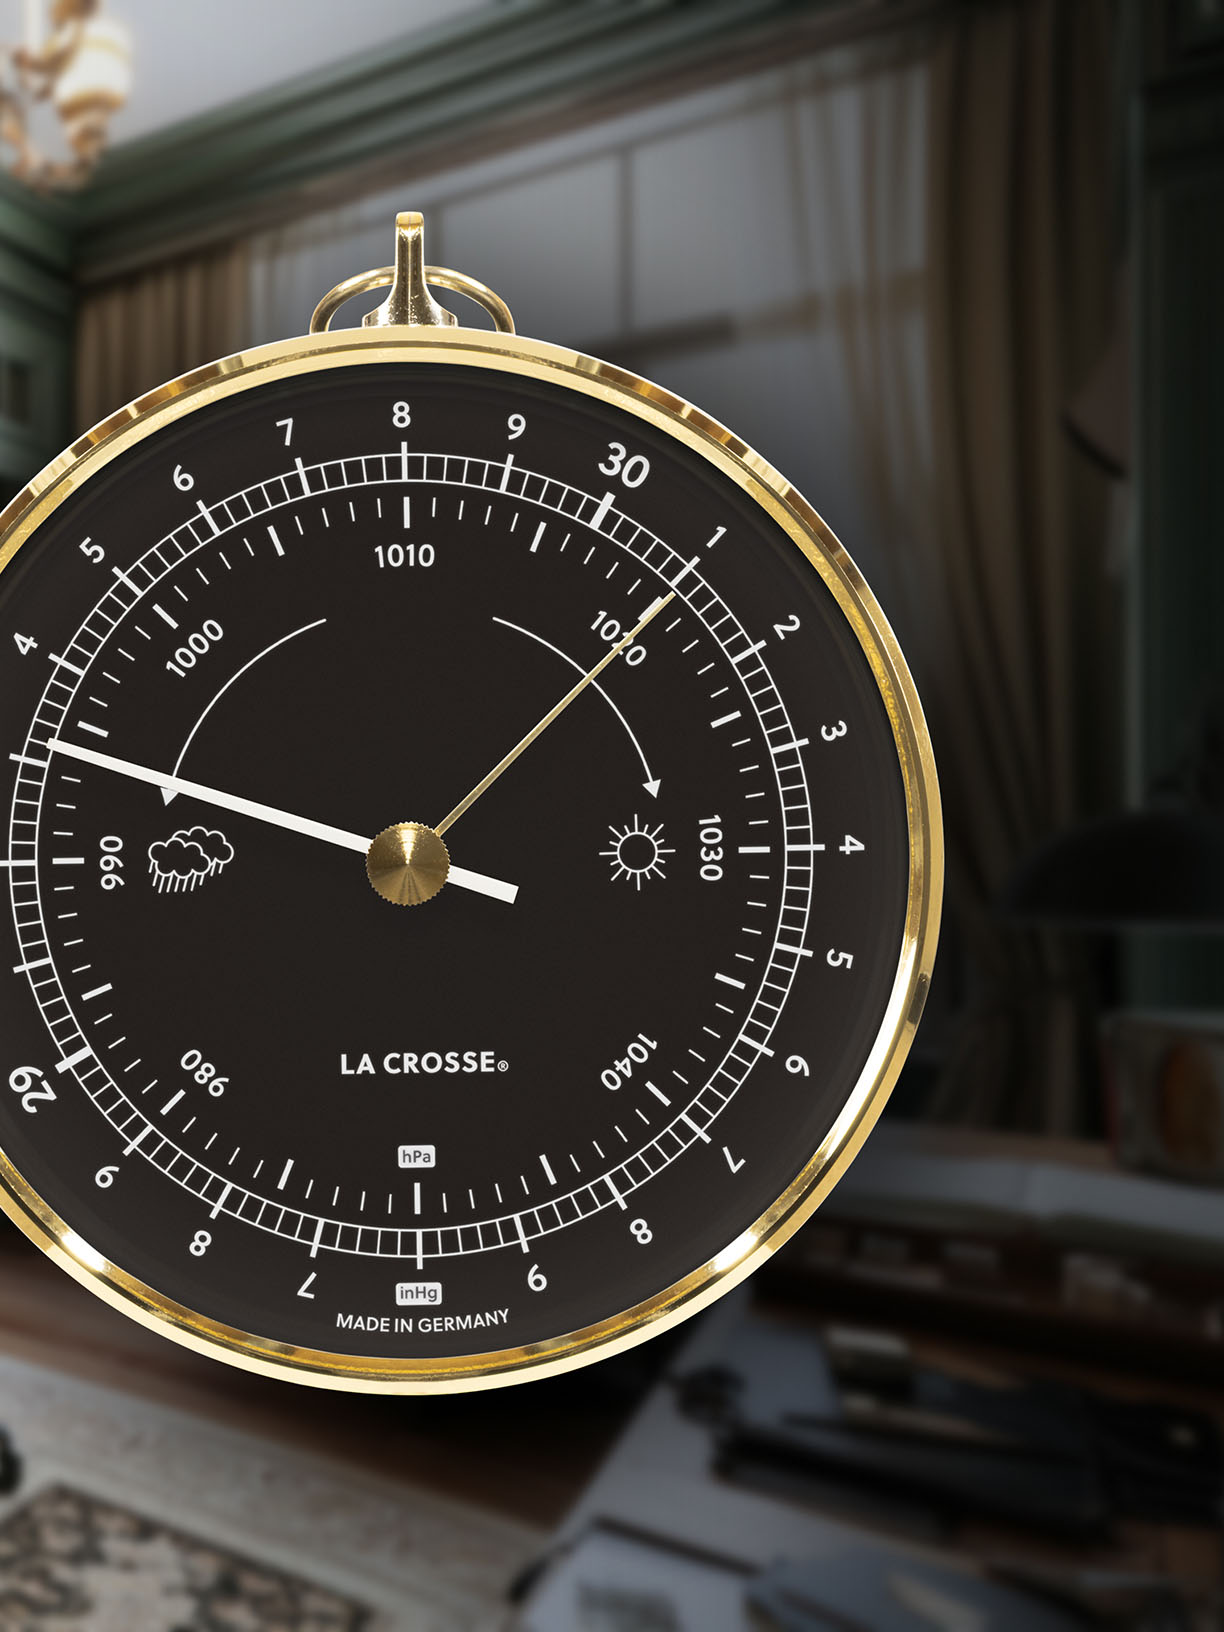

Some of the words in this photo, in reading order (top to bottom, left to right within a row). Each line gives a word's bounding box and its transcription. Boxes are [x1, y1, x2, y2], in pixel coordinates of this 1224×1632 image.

[393, 401, 411, 428] 8
[508, 414, 526, 440] 9
[276, 418, 293, 446] 7
[173, 465, 194, 491] 6
[598, 442, 650, 488] 30
[79, 537, 104, 563] 5
[706, 526, 727, 548] 1
[375, 544, 434, 568] 1010
[773, 615, 800, 640] 2
[14, 633, 38, 655] 4
[166, 620, 223, 677] 1000
[821, 720, 847, 741] 3
[699, 815, 723, 881] 1030
[839, 835, 865, 854] 4
[100, 836, 125, 890] 990
[827, 949, 853, 969] 5
[181, 1050, 229, 1097] 980
[341, 1054, 375, 1074] LA
[601, 1033, 657, 1090] 1040
[786, 1055, 809, 1076] 6
[9, 1066, 57, 1113] 29
[402, 1150, 432, 1164] hPa
[723, 1146, 746, 1173] 7
[189, 1230, 211, 1256] 8
[630, 1219, 652, 1244] 8
[297, 1272, 317, 1299] 7
[400, 1286, 438, 1302] inHg
[336, 1313, 390, 1332] MADE
[395, 1318, 412, 1332] IN
[418, 1309, 508, 1332] GERMANY
